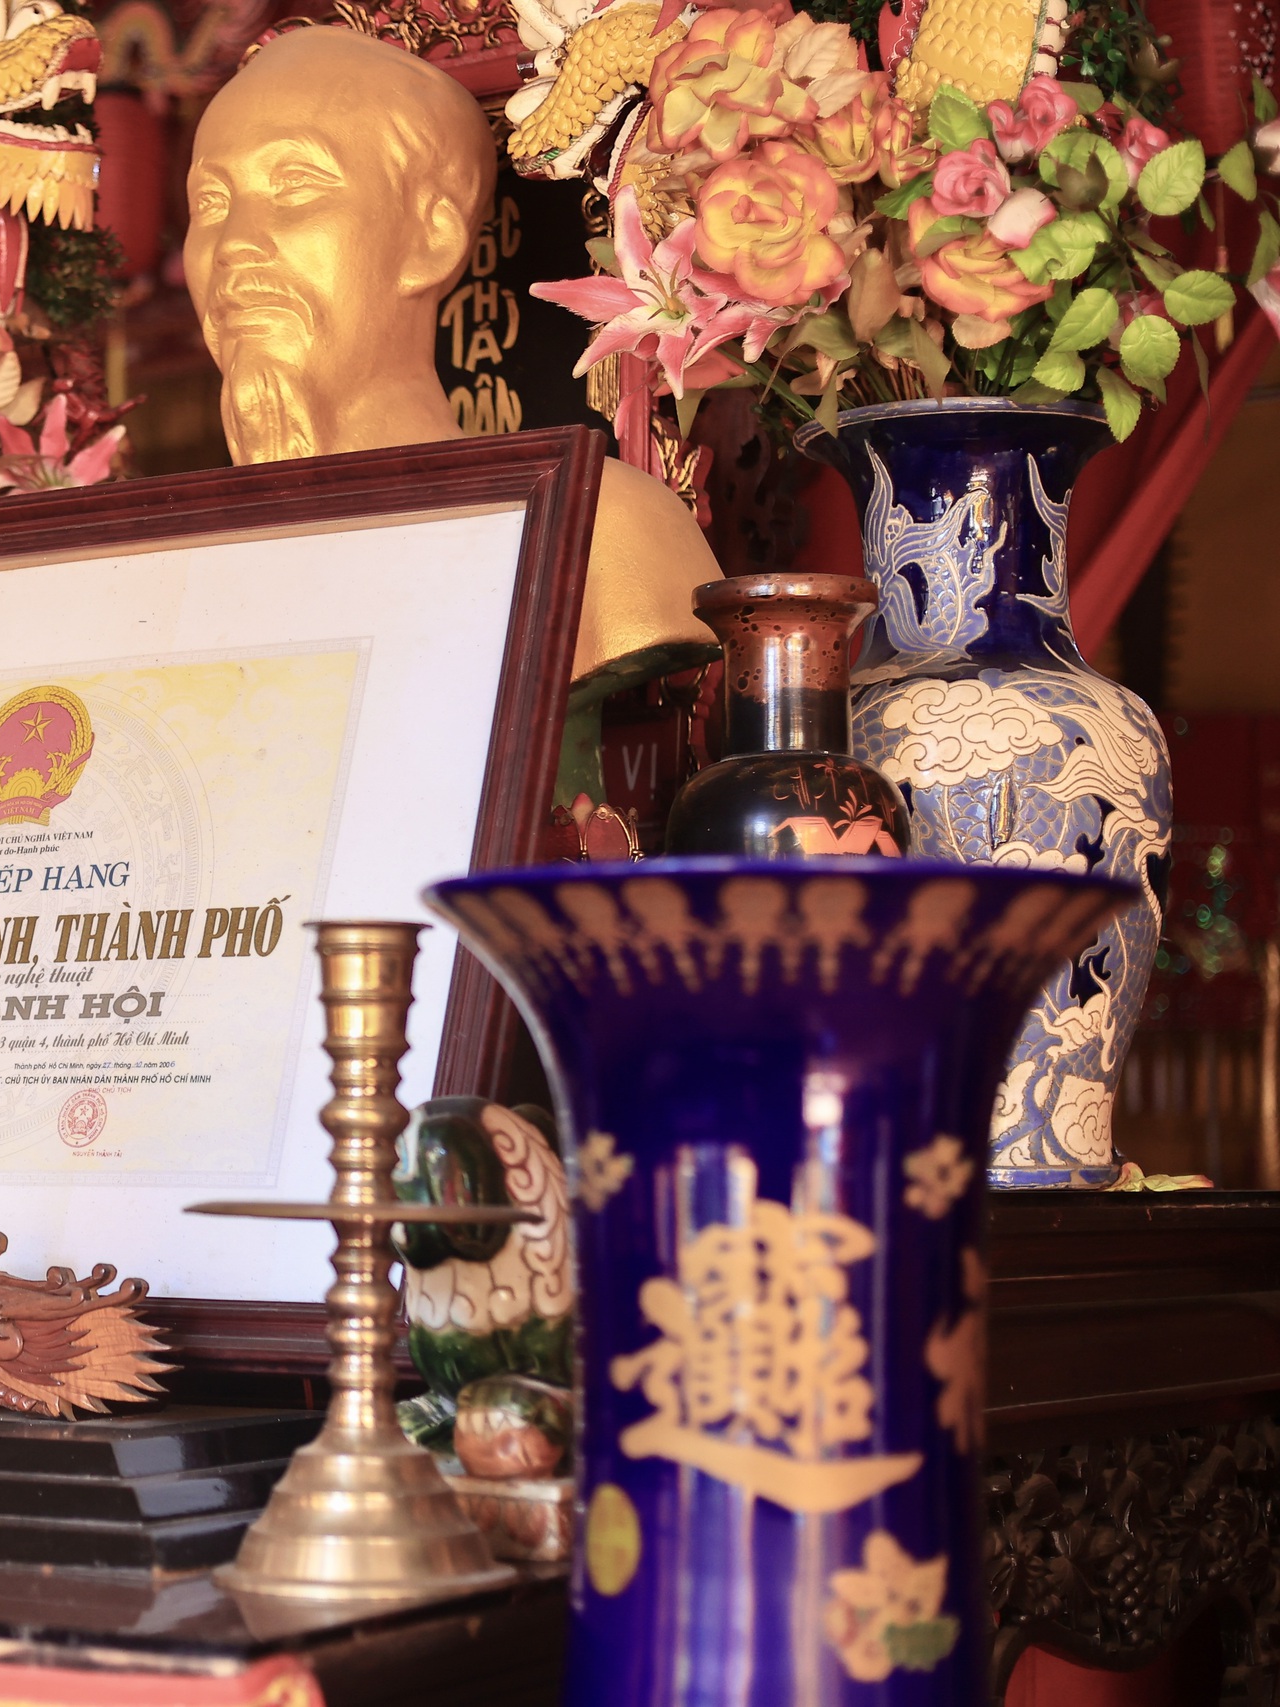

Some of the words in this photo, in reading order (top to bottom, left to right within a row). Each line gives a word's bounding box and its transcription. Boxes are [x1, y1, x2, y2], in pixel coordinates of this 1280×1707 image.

[53, 831, 72, 842] VIỆT
[73, 831, 94, 840] NAM
[40, 861, 130, 893] HẠNG
[53, 901, 195, 963] THÀNH
[197, 894, 292, 958] PHỐ
[4, 967, 45, 988] nghệ
[49, 966, 94, 987] thuật
[79, 985, 165, 1024] HỘI
[9, 1036, 36, 1052] quận
[52, 1033, 85, 1048] thành
[87, 1031, 111, 1051] phố
[136, 1031, 156, 1046] Chí
[157, 1031, 191, 1046] Minh
[23, 1076, 39, 1086] TỊCH
[52, 1076, 69, 1084] BAN
[141, 1072, 159, 1083] PHỐ
[174, 1073, 190, 1083] CHÍ
[190, 1075, 211, 1083] MINH
